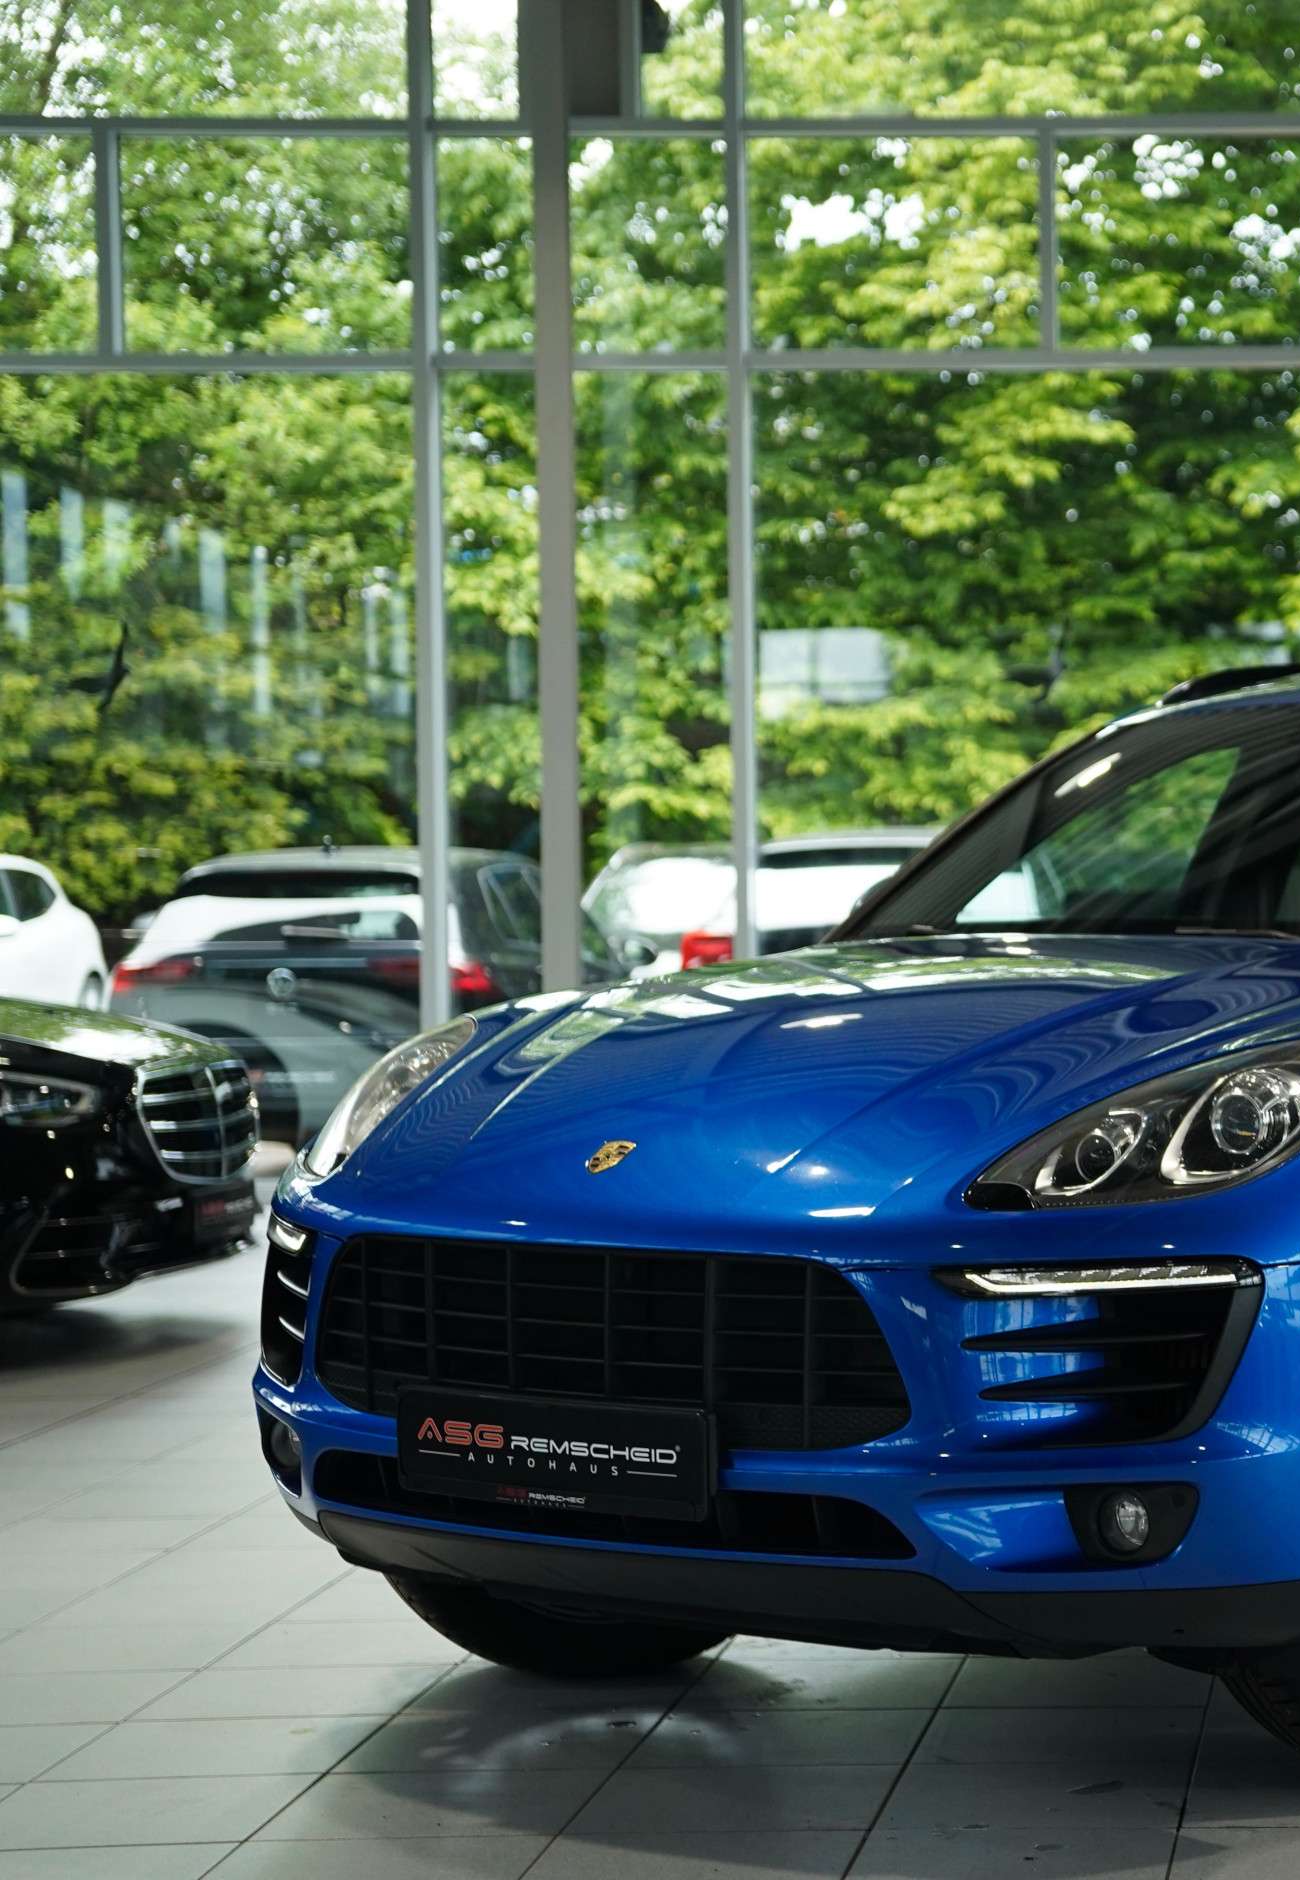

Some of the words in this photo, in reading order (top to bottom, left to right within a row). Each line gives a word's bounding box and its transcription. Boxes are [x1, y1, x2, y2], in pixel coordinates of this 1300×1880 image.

[417, 1417, 504, 1449] ASG
[510, 1435, 678, 1465] REMSCHEID
[468, 1451, 619, 1477] AUTOHAUS
